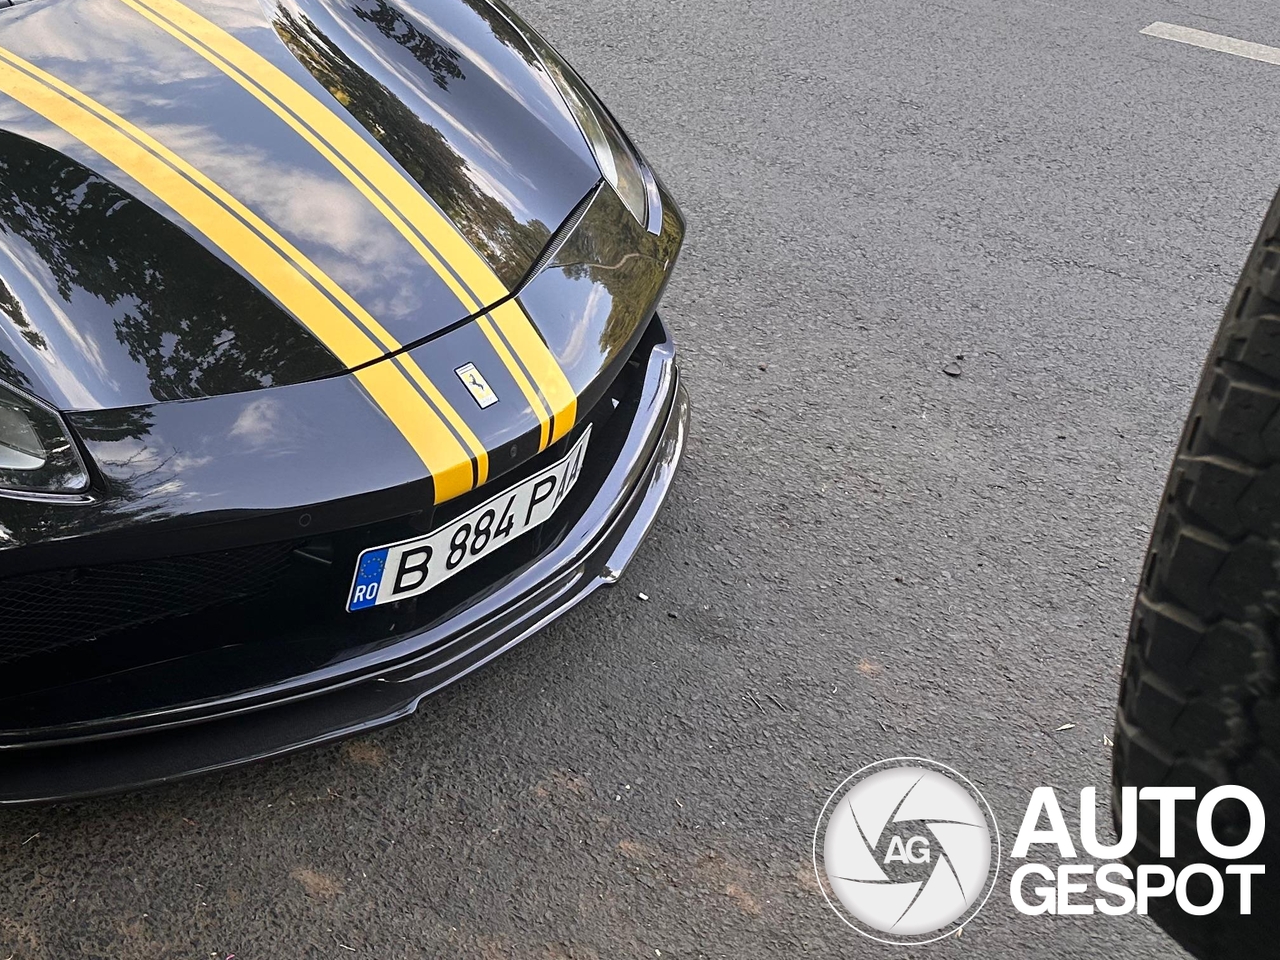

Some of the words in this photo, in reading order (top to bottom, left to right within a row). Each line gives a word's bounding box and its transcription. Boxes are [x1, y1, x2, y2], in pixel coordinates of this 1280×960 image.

[391, 545, 433, 595] B
[446, 494, 517, 570] 884
[353, 583, 378, 603] RO
